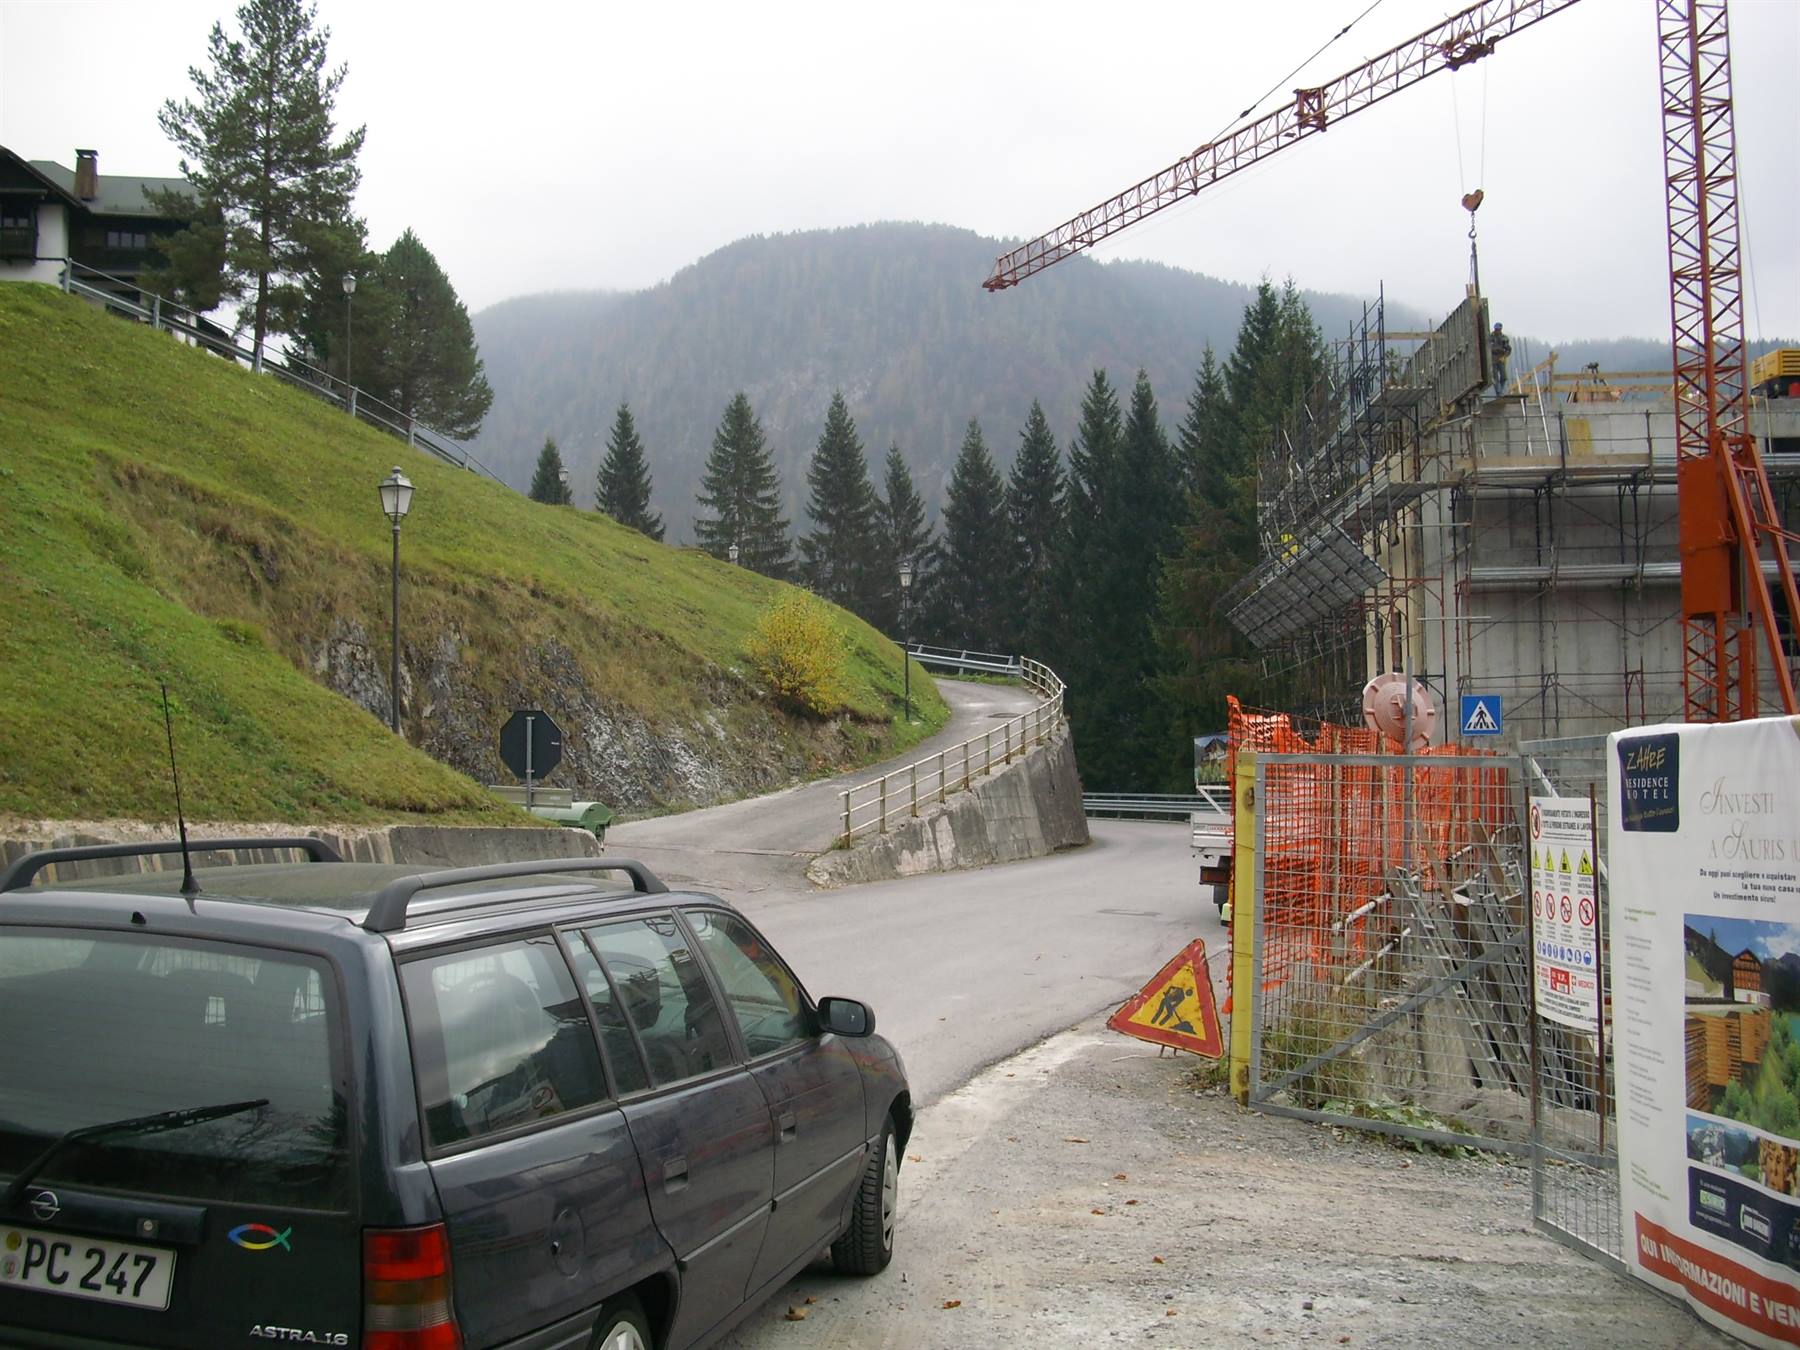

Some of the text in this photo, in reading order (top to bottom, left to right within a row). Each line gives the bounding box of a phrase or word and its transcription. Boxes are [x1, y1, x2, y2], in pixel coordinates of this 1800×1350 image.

[1700, 776, 1774, 815] INVESTI
[1723, 819, 1785, 861] SAURIS
[1732, 870, 1760, 880] scegliere
[1741, 882, 1748, 890] la
[1750, 882, 1761, 891] tua
[1778, 885, 1795, 893] casa
[1721, 893, 1759, 902] investimento
[22, 1237, 157, 1298] PC 247
[1640, 1233, 1659, 1259] QUI
[1660, 1243, 1747, 1308] INFORMAZIONI
[1750, 1290, 1761, 1315] E
[249, 1324, 318, 1343] ASTRA
